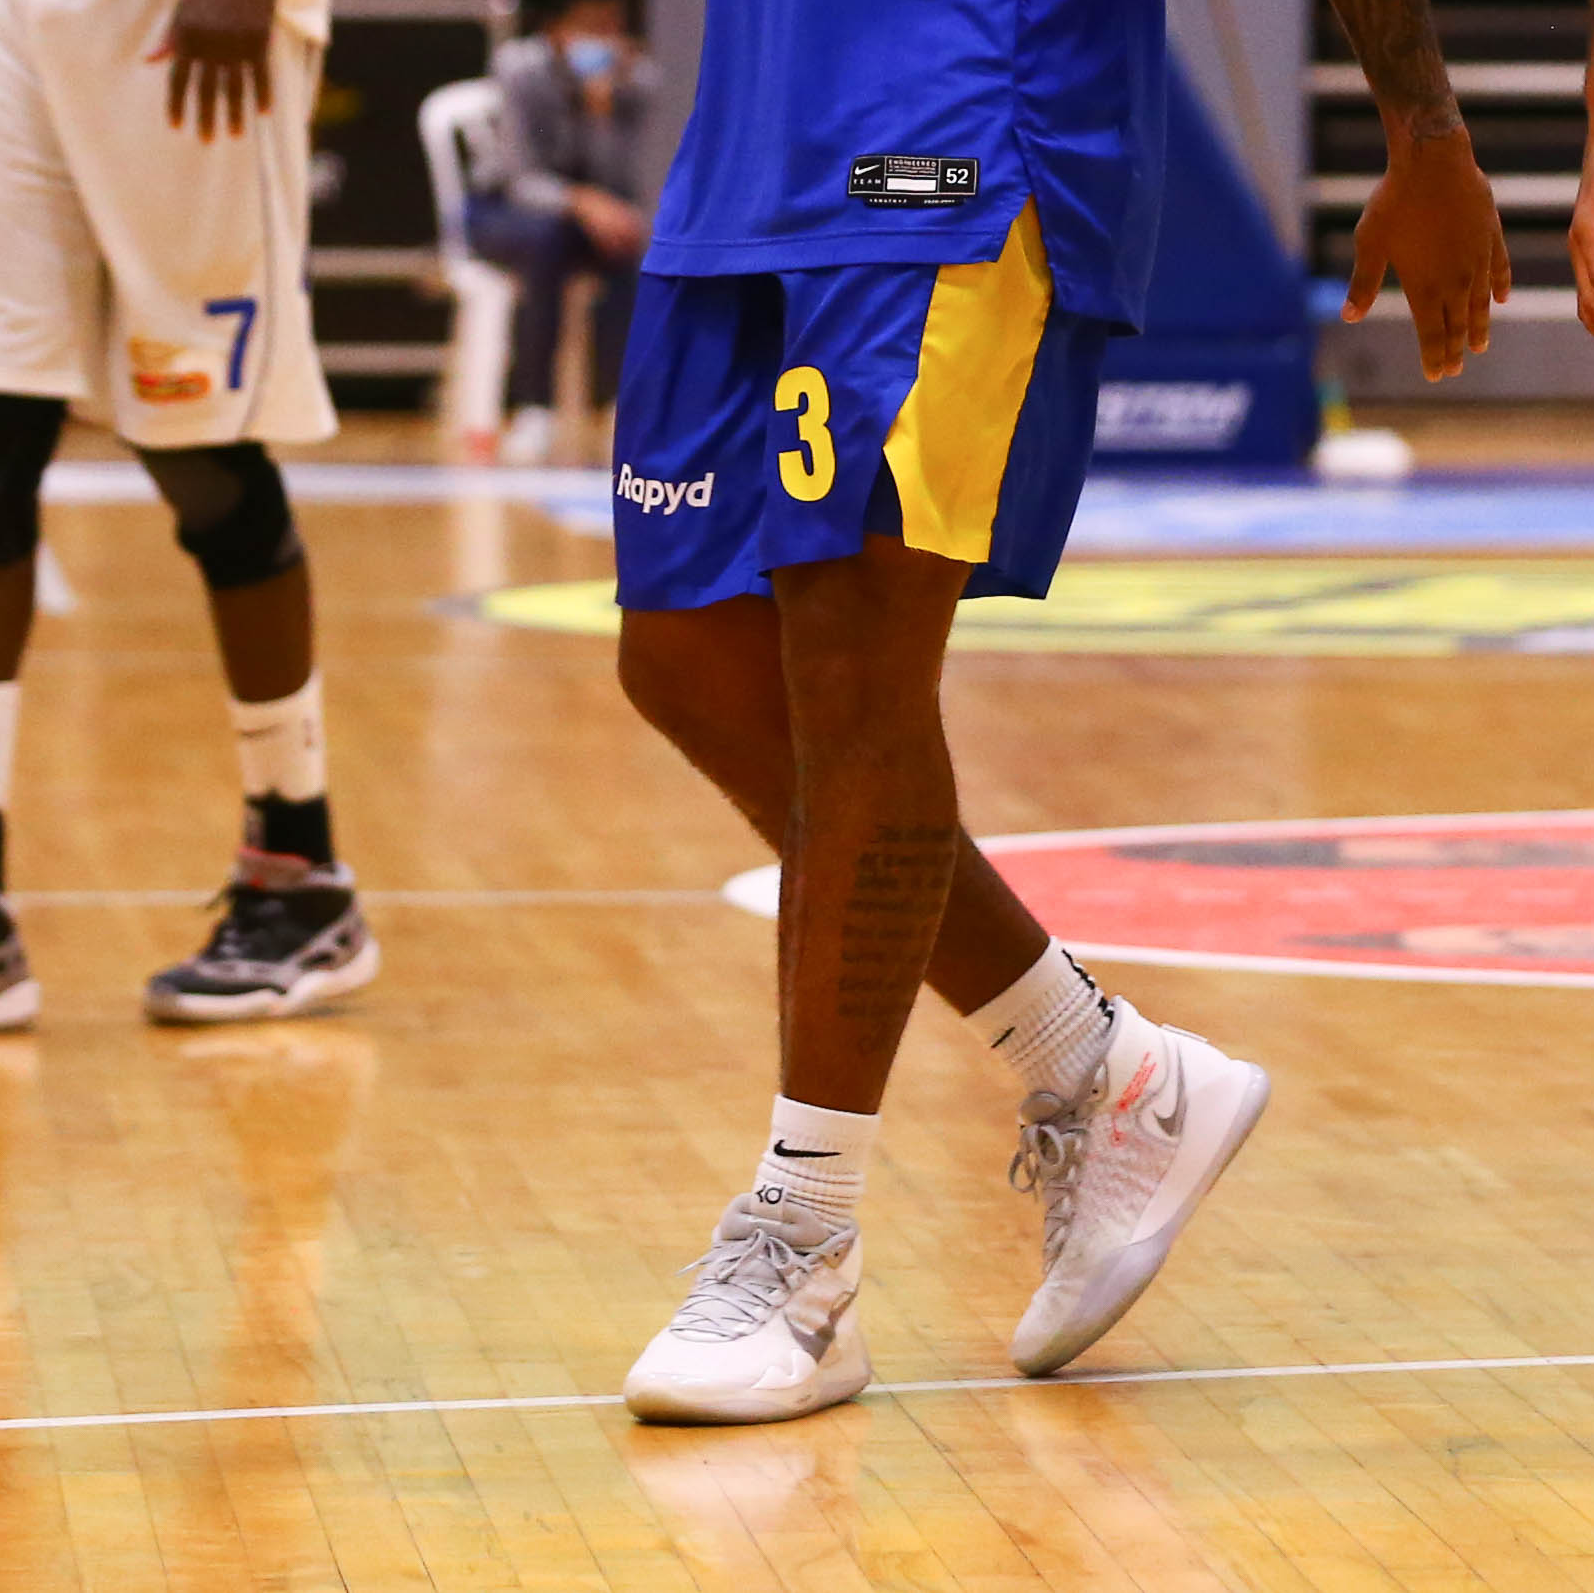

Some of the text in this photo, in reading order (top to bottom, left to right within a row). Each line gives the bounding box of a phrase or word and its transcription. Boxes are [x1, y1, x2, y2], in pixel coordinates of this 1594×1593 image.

[945, 168, 969, 184] 52
[205, 297, 257, 390] 7
[773, 365, 837, 502] 3
[616, 463, 715, 516] Rapyd
